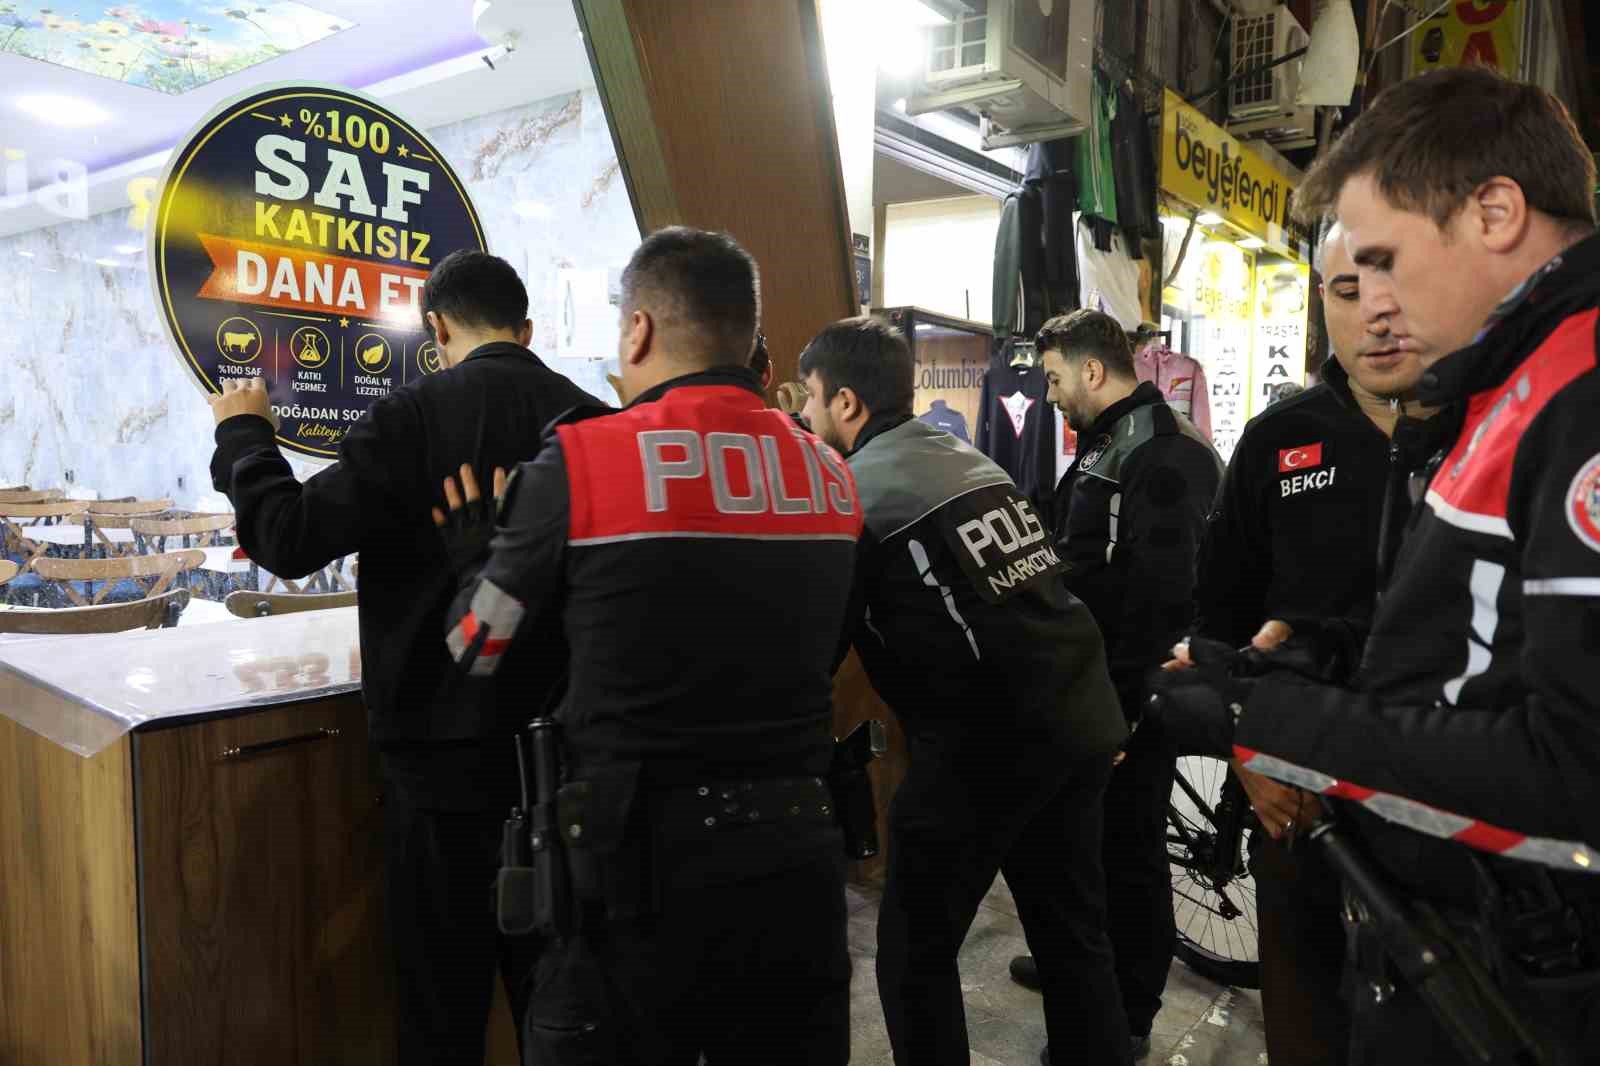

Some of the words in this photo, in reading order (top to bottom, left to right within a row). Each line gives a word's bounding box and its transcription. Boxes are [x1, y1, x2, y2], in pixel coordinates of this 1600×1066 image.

[299, 108, 390, 154] %100
[254, 134, 431, 223] SAF
[1175, 111, 1279, 223] beyefendi
[254, 201, 432, 265] KATKISIZ
[235, 249, 367, 311] DANA
[380, 272, 426, 314] ET
[218, 364, 243, 375] %100
[245, 366, 263, 376] SAF
[298, 370, 322, 381] KATKI
[354, 375, 381, 386] DOĞAL
[381, 377, 392, 386] VE
[911, 358, 985, 391] Columbia
[271, 404, 339, 420] DOĞADAN
[297, 422, 343, 442] Kaliteyi
[1279, 466, 1337, 498] BEKÇİ
[954, 496, 1046, 568] POLİS
